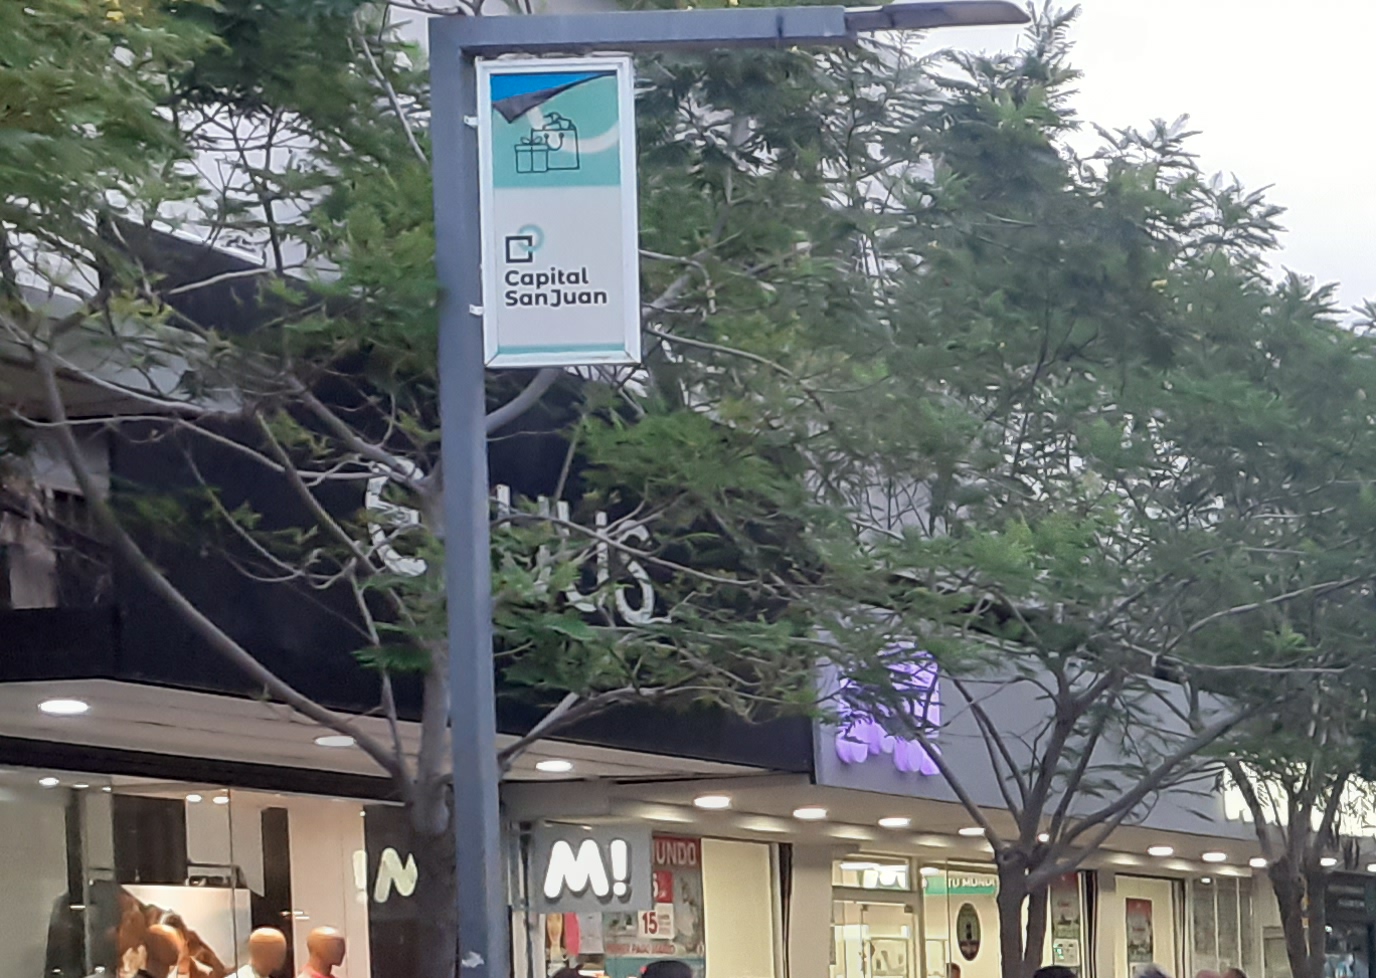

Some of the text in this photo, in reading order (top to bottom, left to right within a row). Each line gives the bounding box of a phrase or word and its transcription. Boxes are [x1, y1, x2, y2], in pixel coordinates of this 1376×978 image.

[505, 267, 589, 289] Capital
[544, 839, 629, 898] M!
[642, 911, 658, 935] 15
